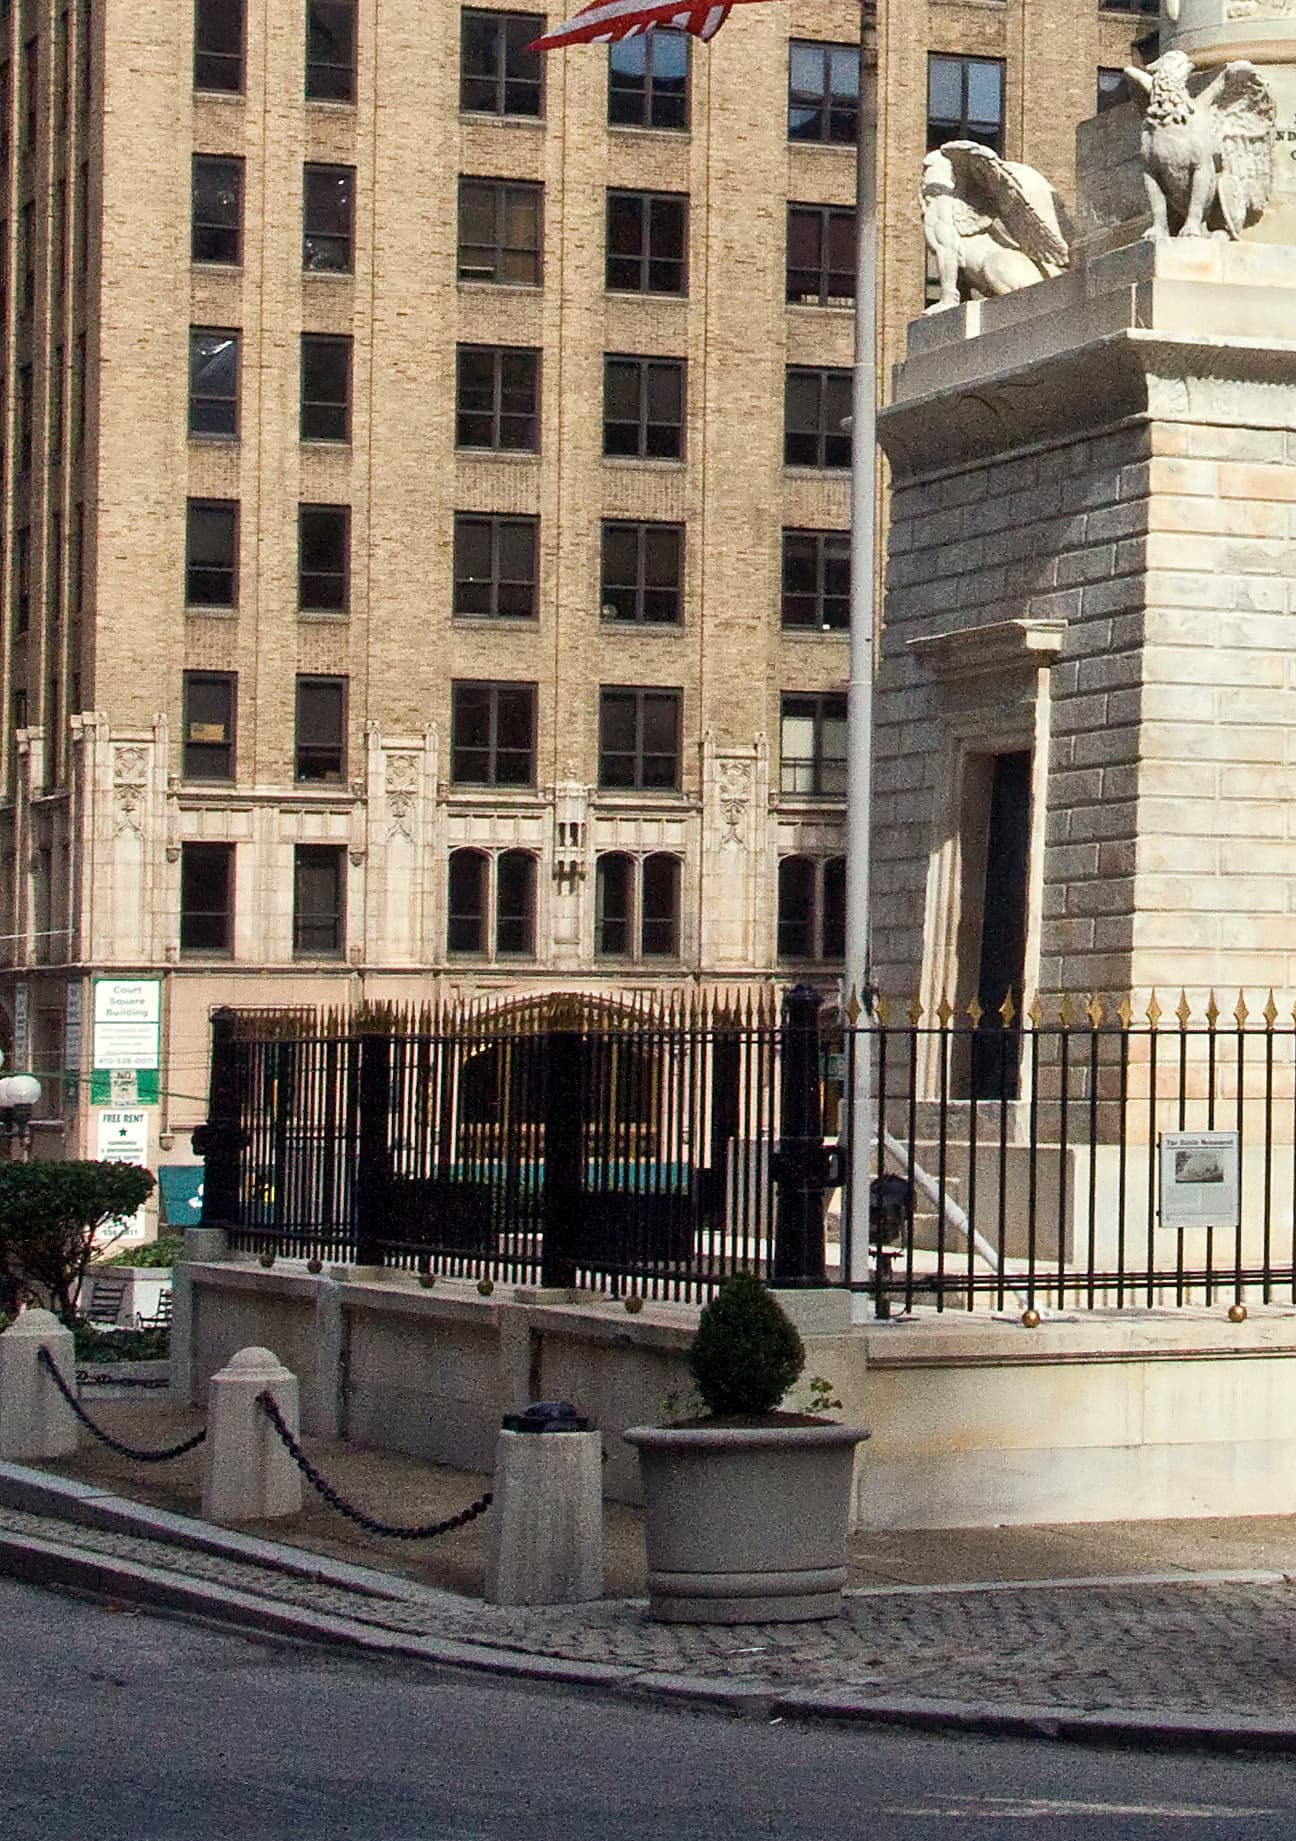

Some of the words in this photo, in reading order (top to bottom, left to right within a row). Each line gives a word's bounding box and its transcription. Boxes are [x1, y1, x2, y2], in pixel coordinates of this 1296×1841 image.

[1275, 130, 1296, 142] ND
[112, 985, 142, 995] Court
[110, 997, 145, 1008] Square
[105, 1009, 149, 1019] Building
[102, 1113, 121, 1123] FREE
[123, 1113, 145, 1123] RENT
